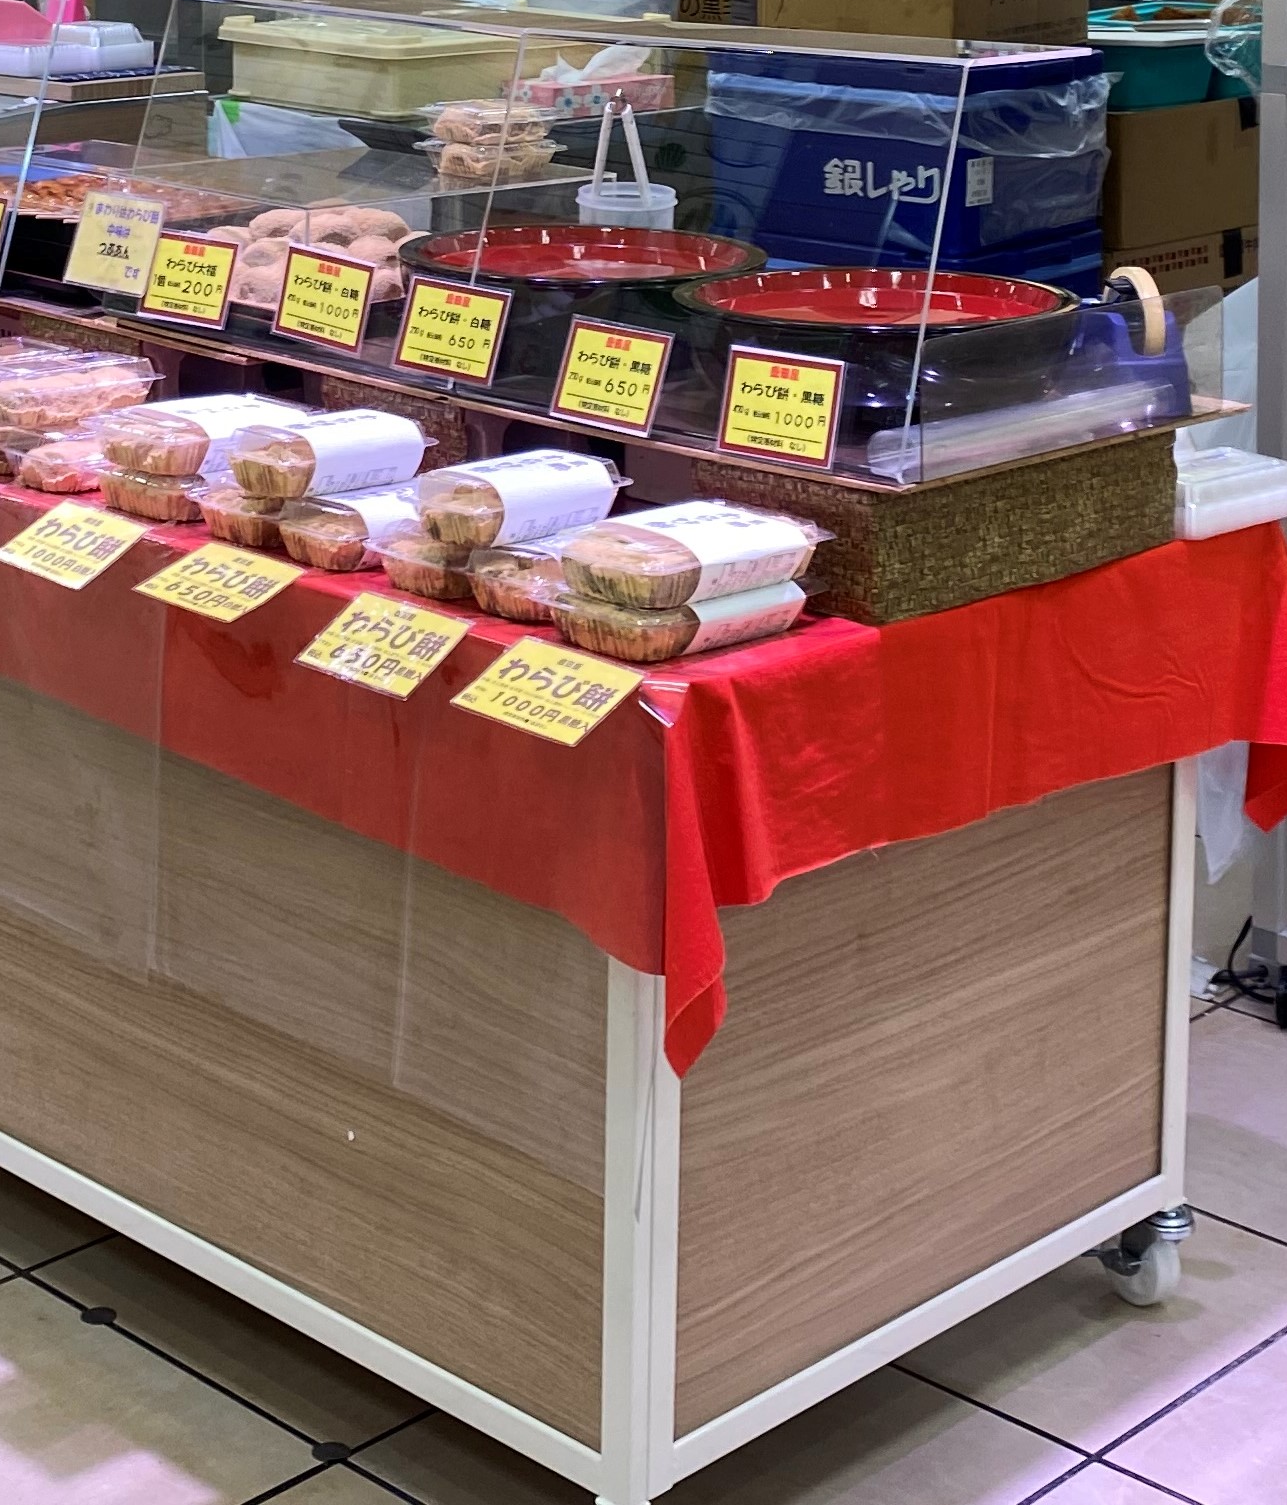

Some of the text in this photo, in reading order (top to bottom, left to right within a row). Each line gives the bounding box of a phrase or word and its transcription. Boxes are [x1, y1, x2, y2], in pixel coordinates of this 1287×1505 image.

[823, 158, 940, 204] 銀しゃり
[35, 517, 127, 562] わらび餅
[179, 557, 280, 600] わらび餅
[341, 611, 450, 662] わらび餅
[498, 658, 620, 713] わらび餅
